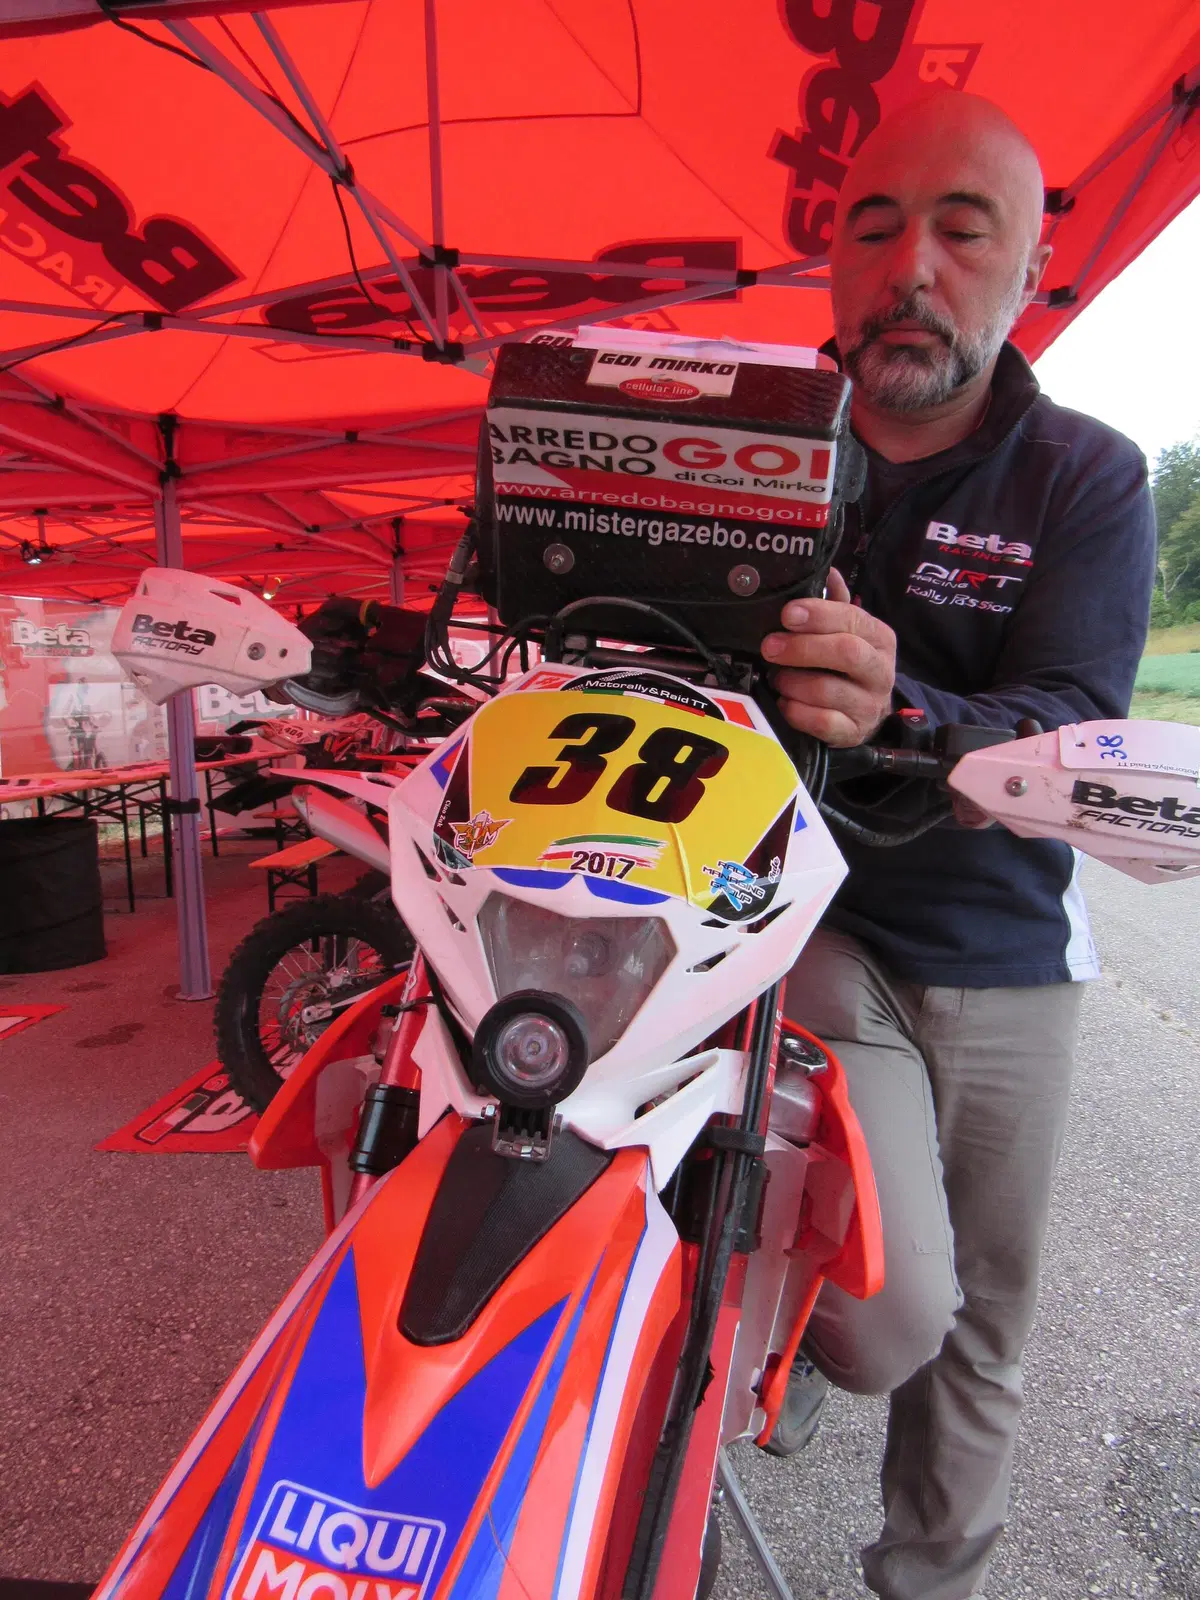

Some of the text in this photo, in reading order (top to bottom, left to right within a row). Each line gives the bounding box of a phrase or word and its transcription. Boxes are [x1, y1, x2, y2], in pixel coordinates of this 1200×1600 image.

[598, 353, 736, 376] GOI MIRKO
[625, 382, 670, 393] cellular
[672, 386, 694, 395] line
[489, 423, 658, 454] ARREDO
[662, 437, 831, 480] GOI
[675, 472, 826, 494] di Goi Mirko
[494, 484, 830, 523] ww.arredobagnogoi.it
[496, 502, 815, 556] www.mistergazebo.com
[926, 521, 1032, 559] Beta
[938, 544, 1002, 562] RACING
[916, 562, 1022, 589] DIRT
[906, 585, 1012, 613] Rally Passion
[12, 621, 90, 647] Beta
[131, 614, 217, 647] Beta
[132, 635, 205, 656] FACTORY
[1096, 735, 1128, 760] 38
[509, 713, 730, 824] 38
[1078, 810, 1200, 838] FACTORY
[569, 850, 635, 880] 2017
[718, 861, 758, 878] RALLY
[269, 1491, 432, 1576] LIQUI
